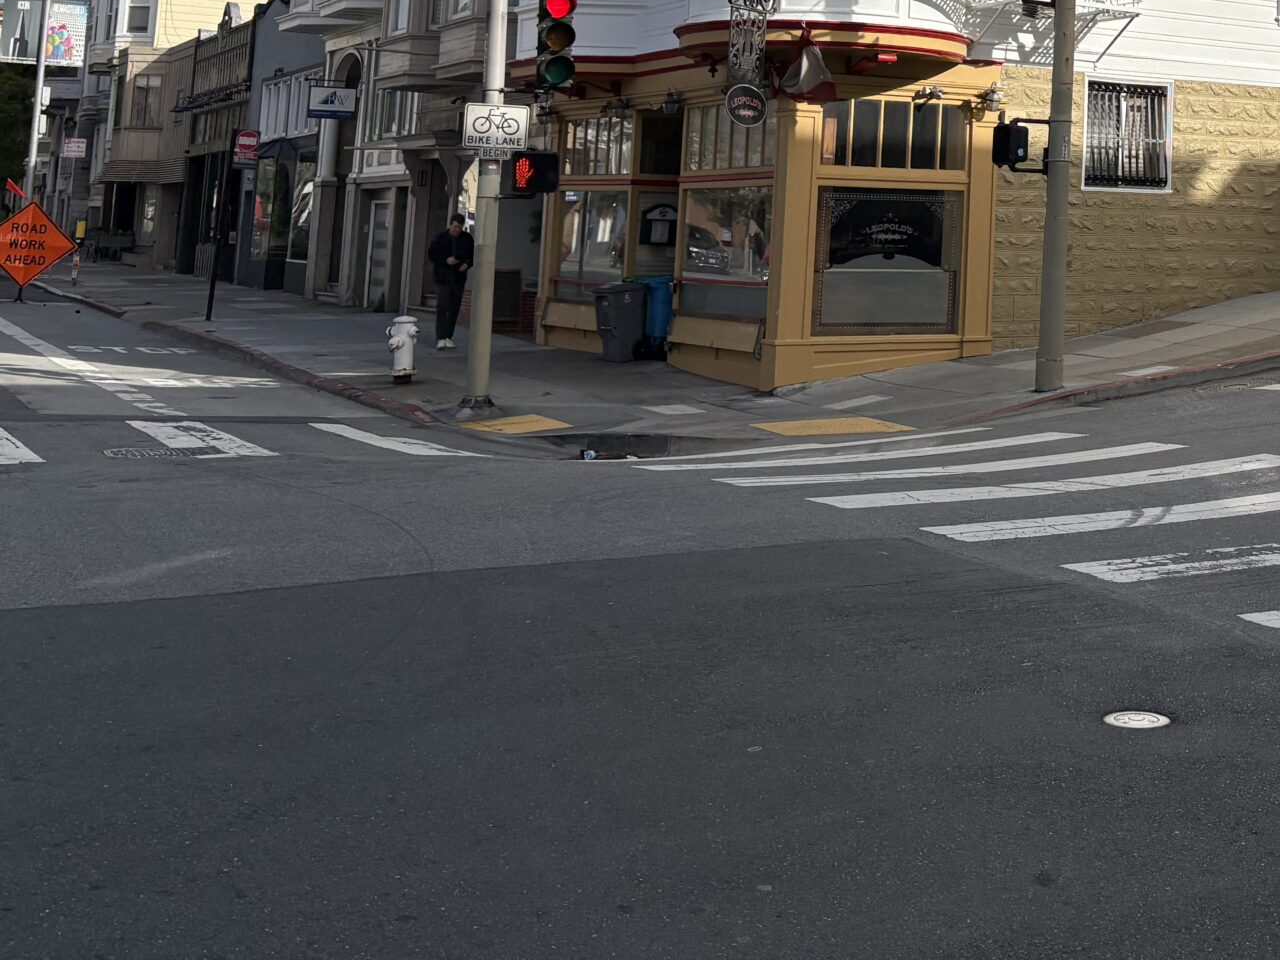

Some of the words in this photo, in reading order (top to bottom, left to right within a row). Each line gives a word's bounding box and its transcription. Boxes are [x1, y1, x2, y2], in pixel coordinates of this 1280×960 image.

[17, 1, 31, 10] ICON
[467, 135, 492, 145] BIKE
[495, 137, 523, 147] LANE
[482, 148, 508, 158] BEGIN
[11, 222, 48, 235] ROAD
[9, 238, 46, 250] WORK
[3, 254, 46, 266] AHEAD
